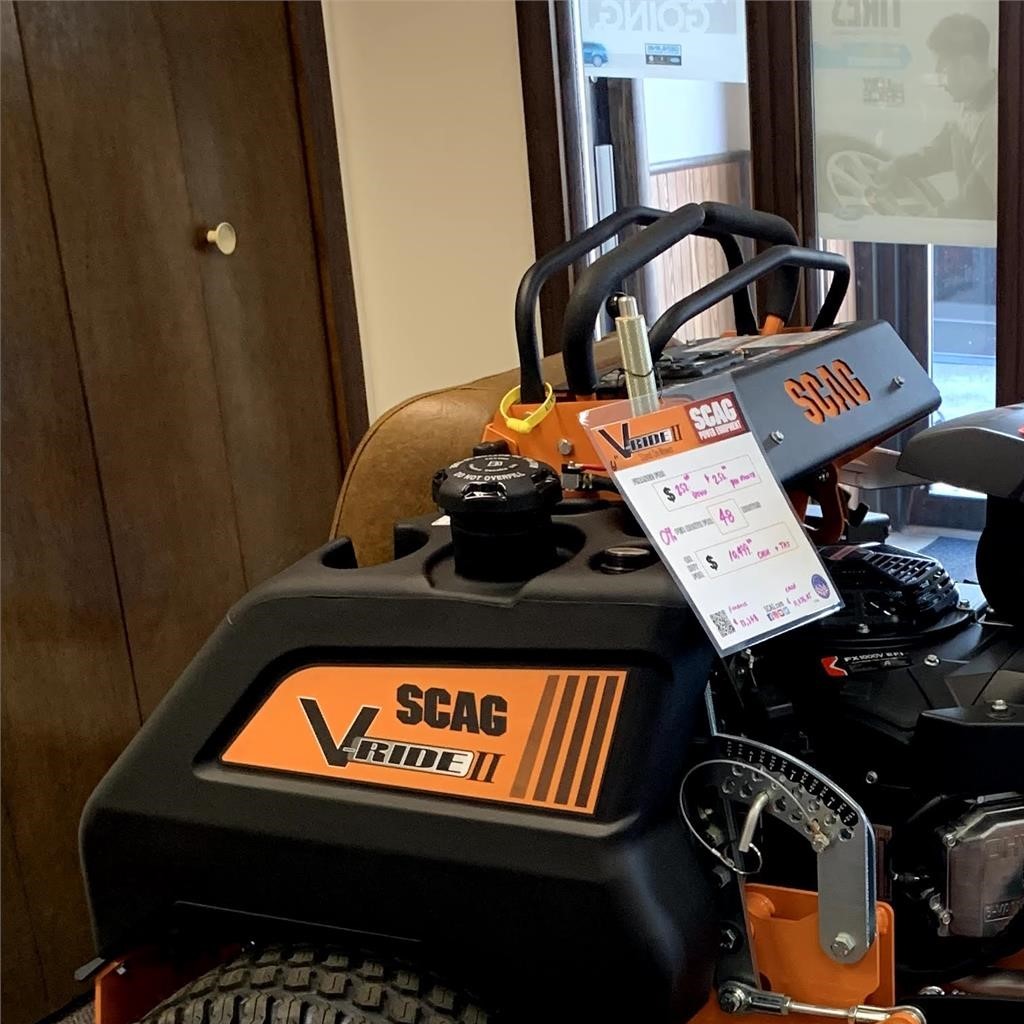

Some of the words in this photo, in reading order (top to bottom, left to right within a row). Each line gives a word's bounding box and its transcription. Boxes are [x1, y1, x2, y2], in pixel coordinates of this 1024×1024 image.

[784, 358, 871, 425] SCAG
[689, 398, 738, 431] SCAG
[484, 472, 526, 481] OVERFILL
[663, 487, 676, 503] $
[719, 507, 736, 526] 48
[706, 555, 719, 571] $
[396, 683, 508, 738] SCAG
